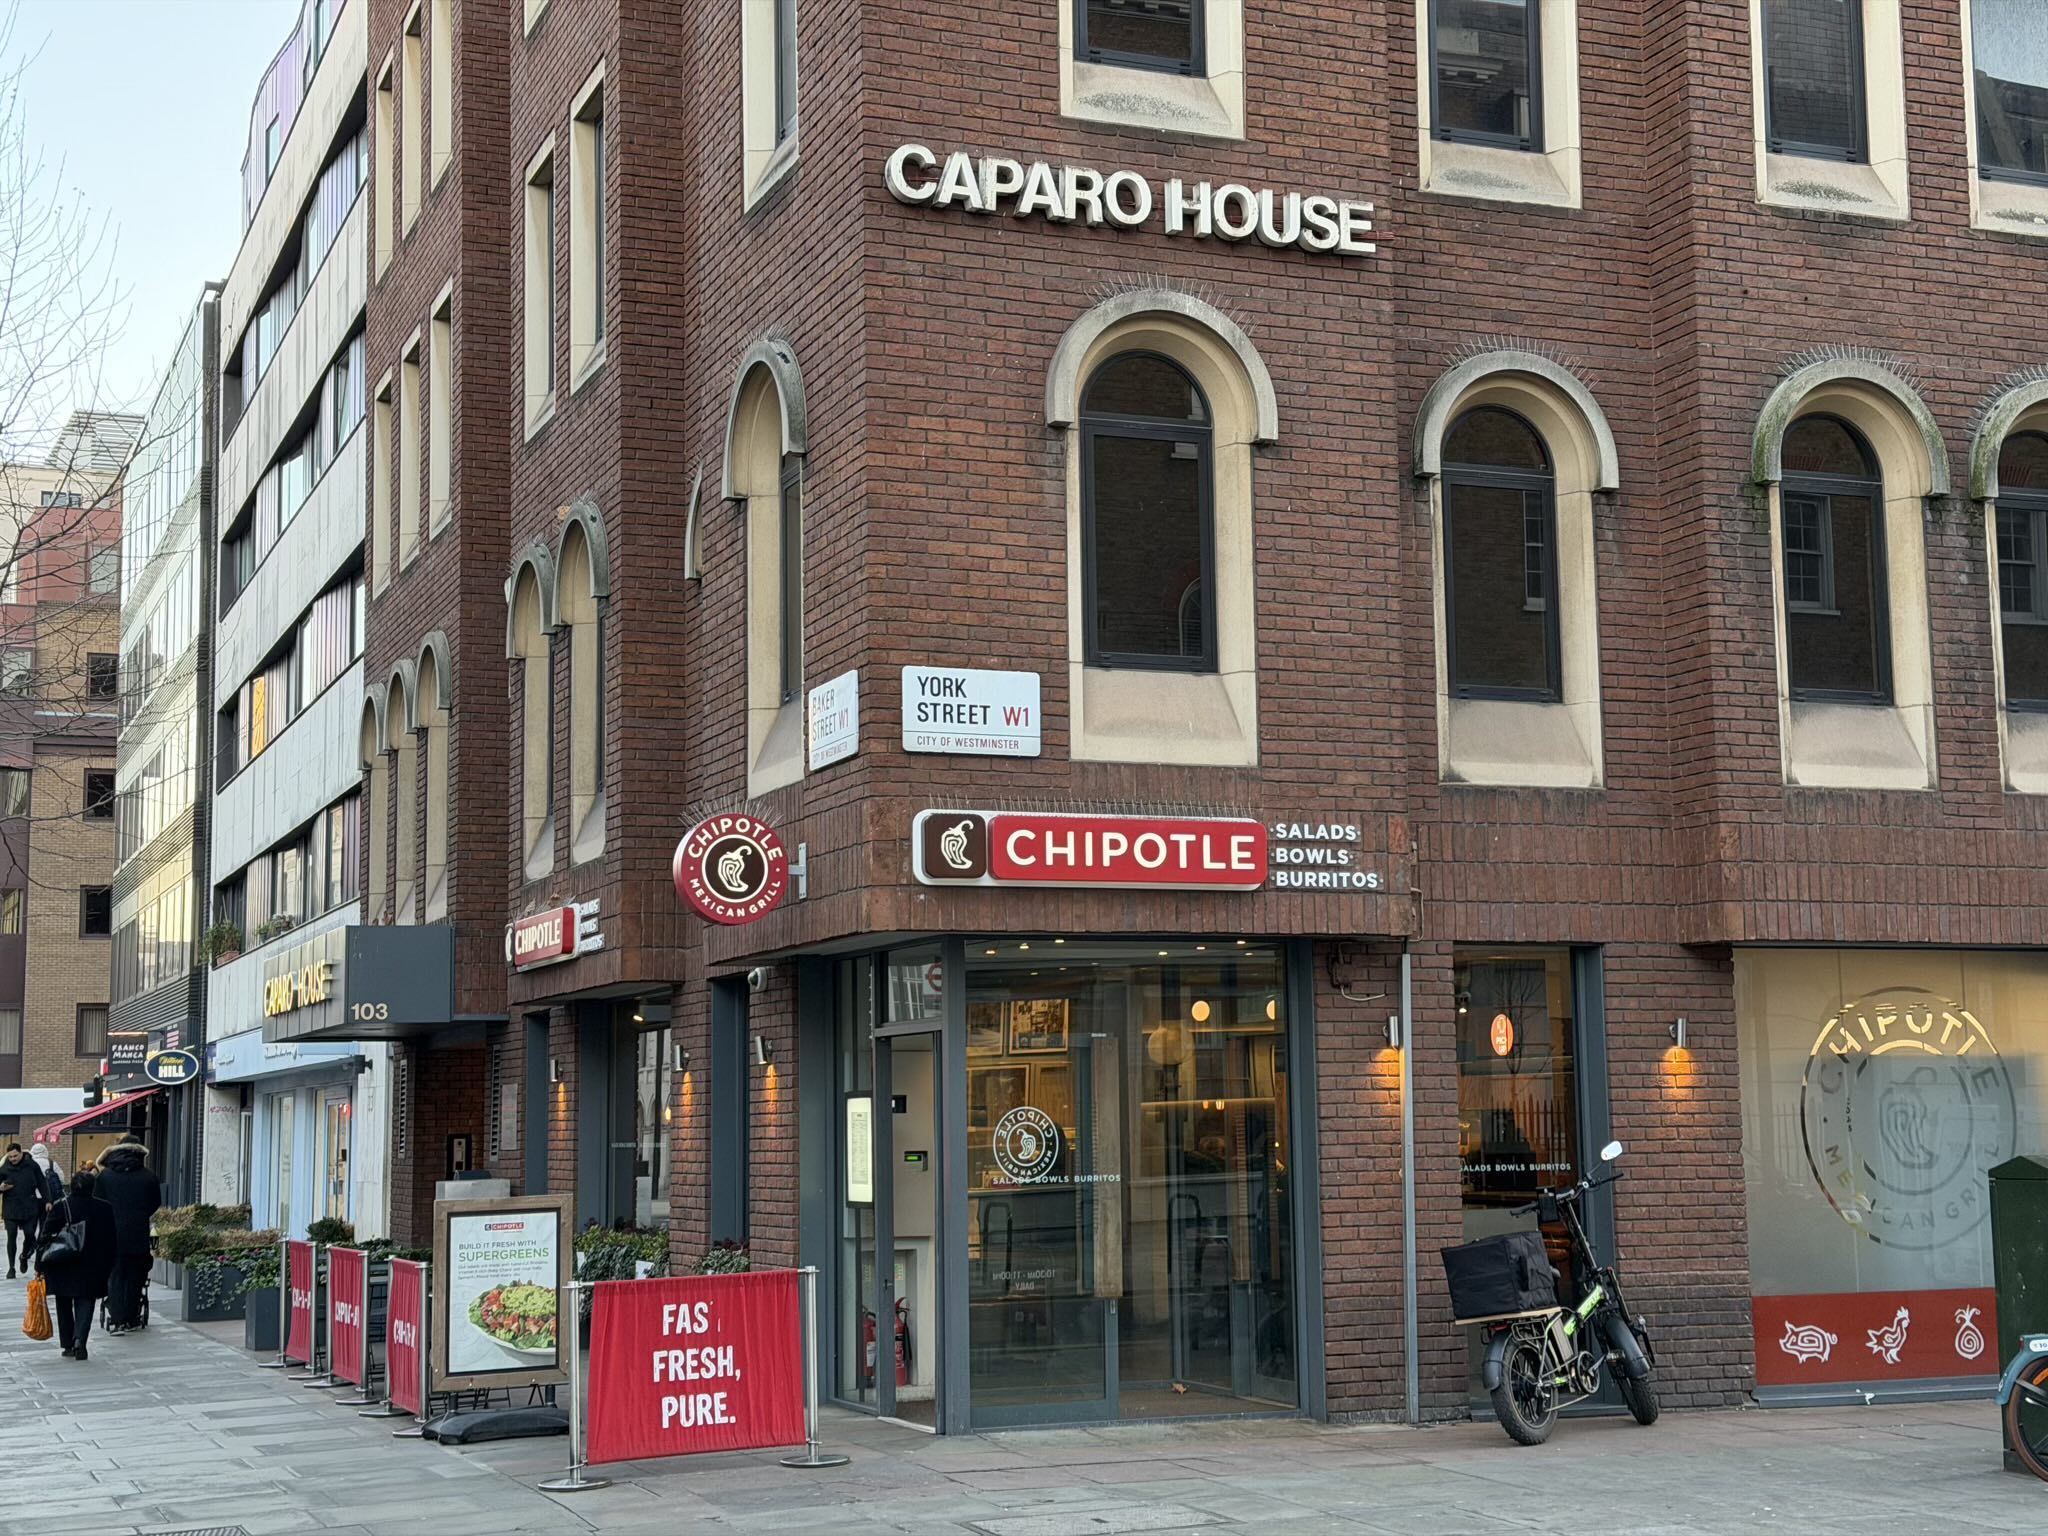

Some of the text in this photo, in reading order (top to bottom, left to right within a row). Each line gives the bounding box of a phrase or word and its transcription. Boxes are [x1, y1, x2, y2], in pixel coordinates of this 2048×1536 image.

[885, 143, 1377, 255] CAPARO HOUSE
[917, 674, 967, 698] YORK
[813, 689, 835, 717] BAKER
[812, 707, 849, 742] STREET W1
[917, 702, 1030, 727] STREET W1
[917, 735, 1019, 750] CITY OF WESTMINSTER
[687, 817, 784, 862] CHIPOTLE
[1275, 823, 1357, 840] SALADS
[1006, 829, 1256, 871] CHIPOTLE
[1275, 847, 1349, 865] BOWLS
[1276, 871, 1378, 888] BURRITOS
[689, 877, 781, 917] MEXICAN GRILL
[514, 917, 561, 956] CHIPOTLE
[264, 958, 328, 1018] CAPARO HOUSE
[351, 1002, 389, 1021] 103
[111, 1044, 145, 1052] FRANCO
[112, 1051, 144, 1060] MANCA
[158, 1065, 186, 1078] HILL
[1495, 1163, 1526, 1171] BOWLS
[1529, 1162, 1572, 1171] BURRITOS
[1035, 1175, 1070, 1183] BOWLS
[1074, 1174, 1121, 1183] BURRITOS
[491, 1222, 523, 1230] CHIPOTLE
[458, 1247, 550, 1263] SUPERGREENS
[653, 1345, 741, 1382] FRESH,
[661, 1391, 737, 1428] PURE.
